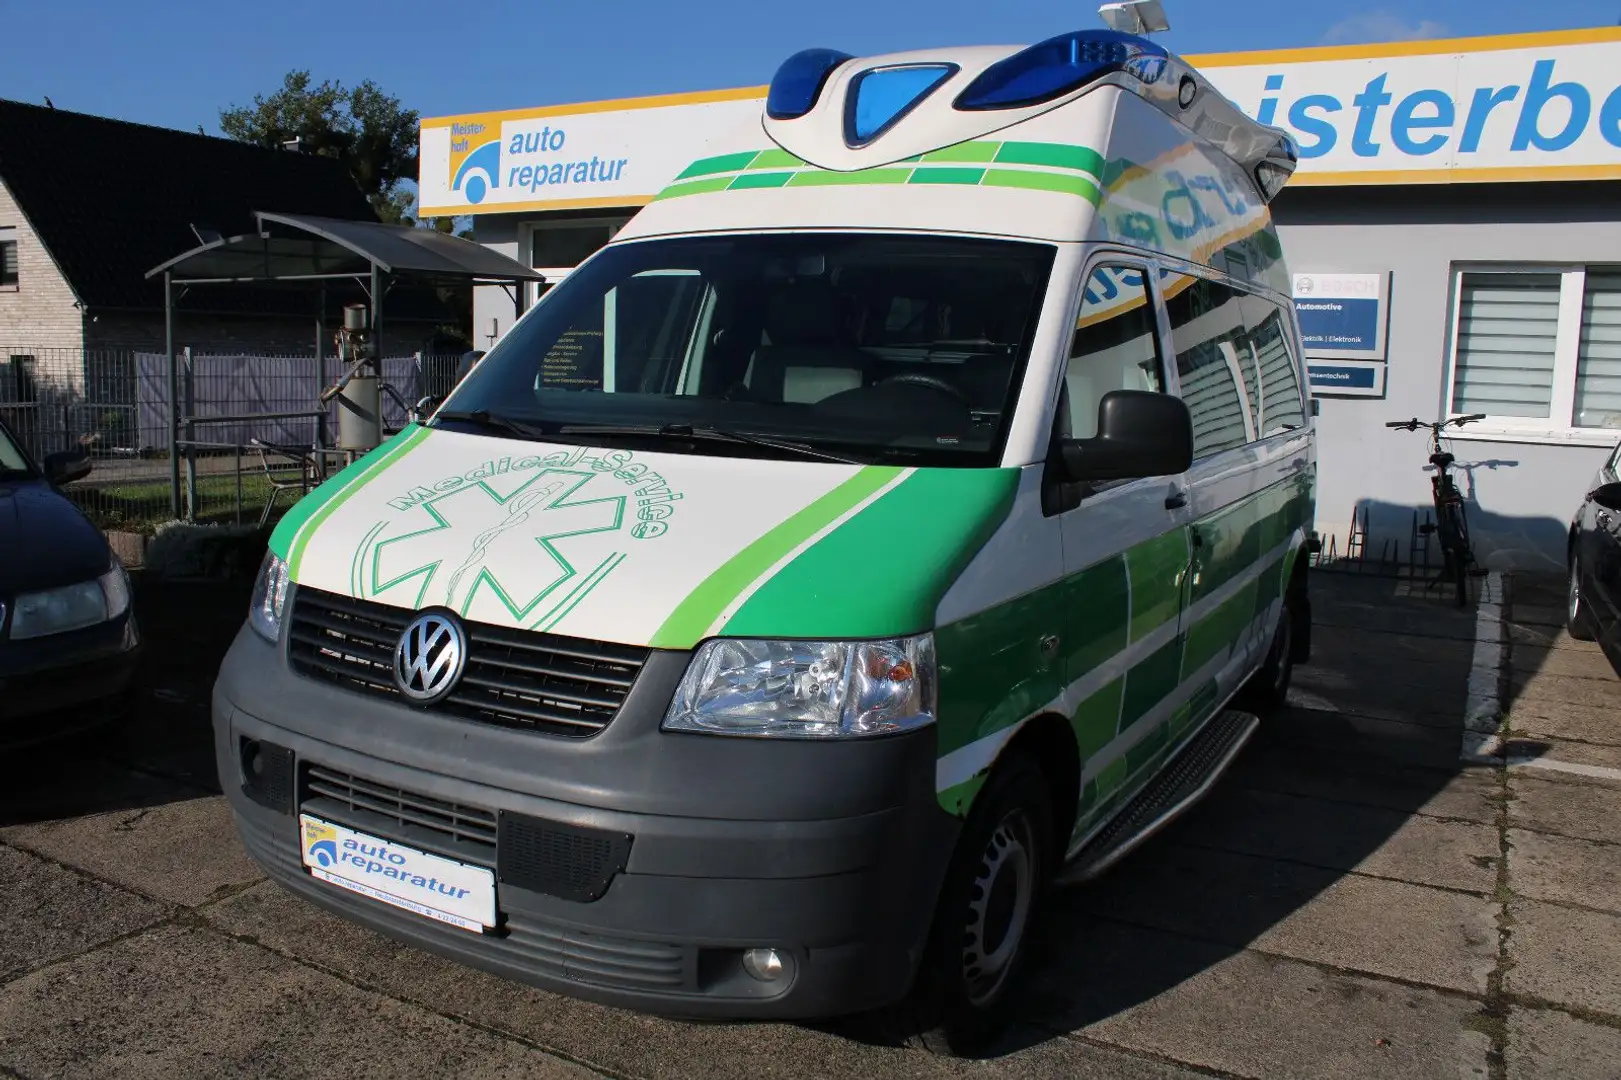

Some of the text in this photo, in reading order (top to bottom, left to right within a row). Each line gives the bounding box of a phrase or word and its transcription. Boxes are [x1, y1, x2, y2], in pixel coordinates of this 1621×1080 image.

[509, 126, 566, 155] auto
[508, 156, 628, 193] reparatur
[1295, 302, 1342, 311] Automotive
[342, 837, 407, 866] auto
[340, 849, 471, 899] reparatur
